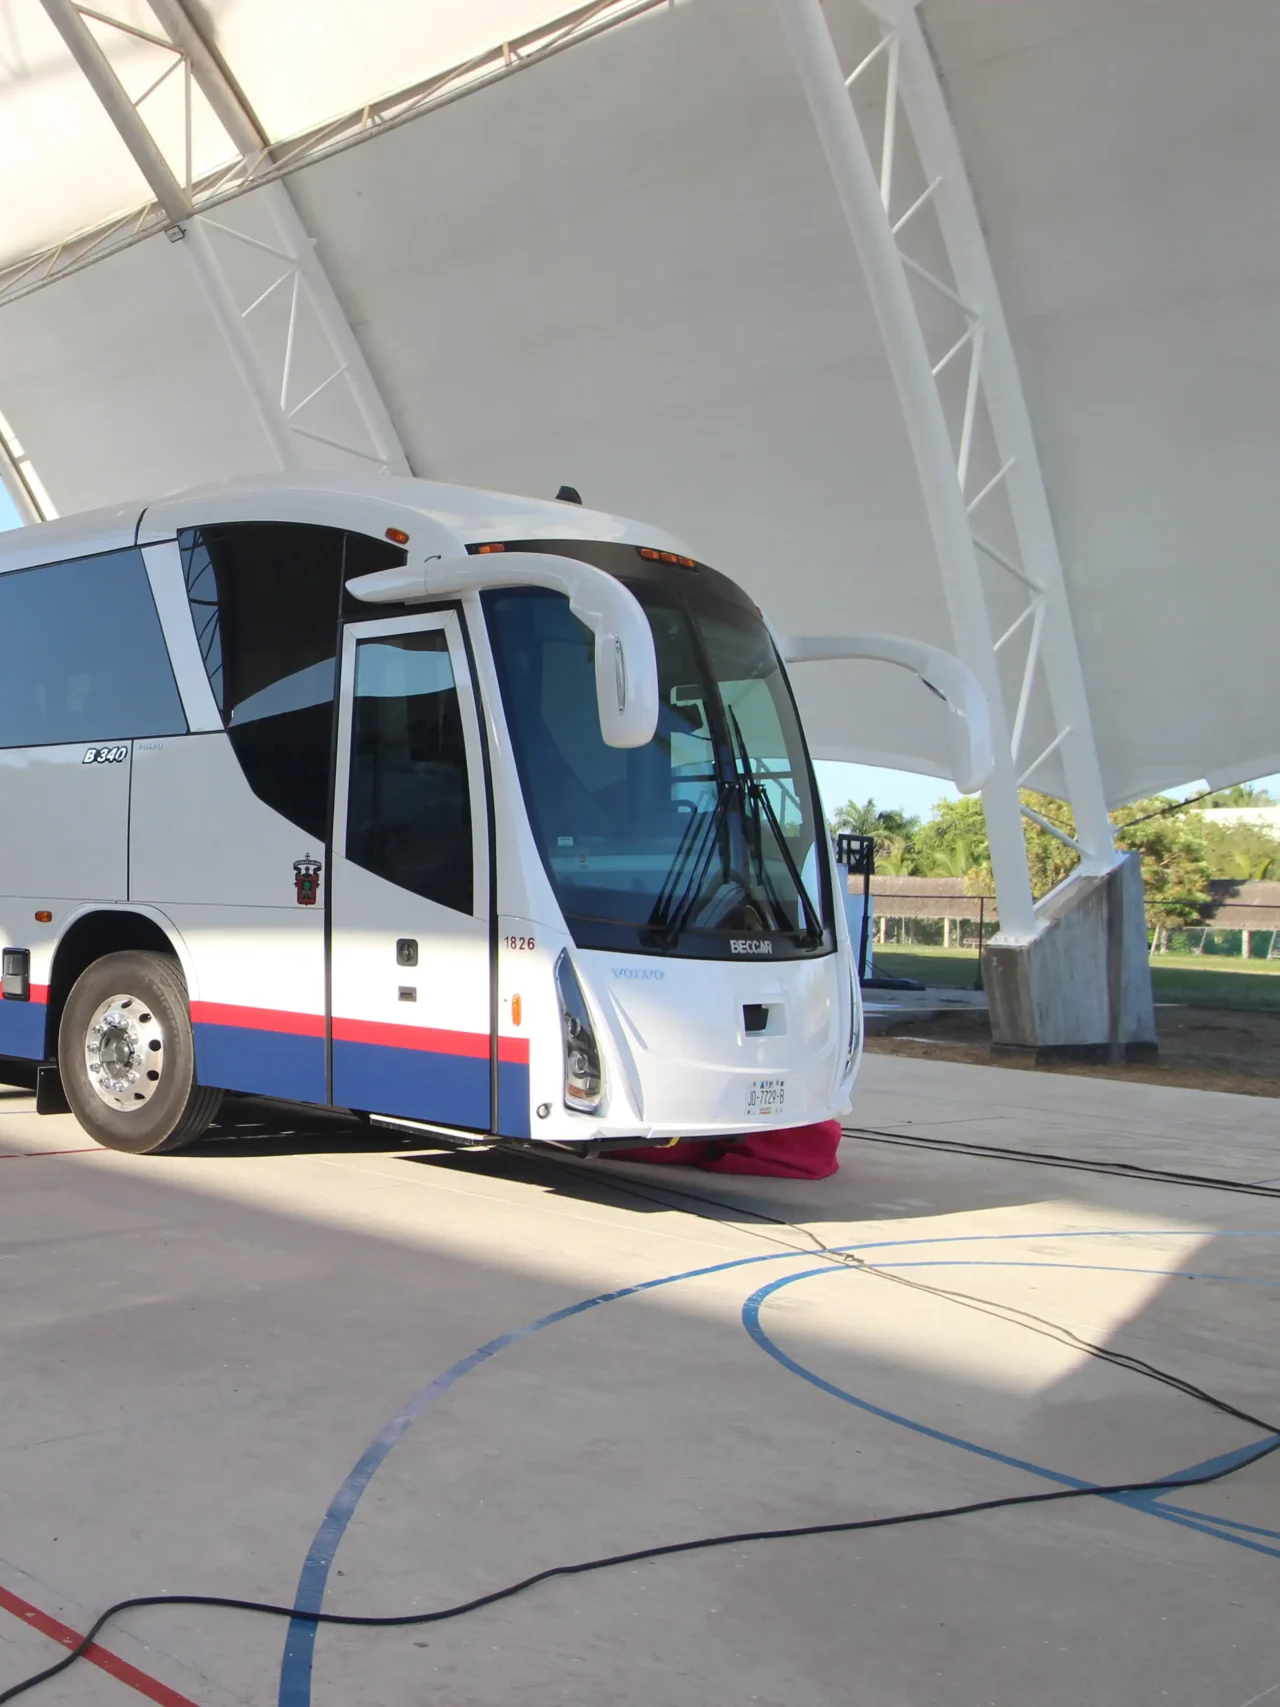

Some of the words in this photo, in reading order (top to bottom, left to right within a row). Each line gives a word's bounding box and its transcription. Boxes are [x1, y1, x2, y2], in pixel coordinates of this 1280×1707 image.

[503, 935, 535, 950] 1826
[729, 939, 772, 954] BECCAR
[610, 967, 665, 980] VOLVO
